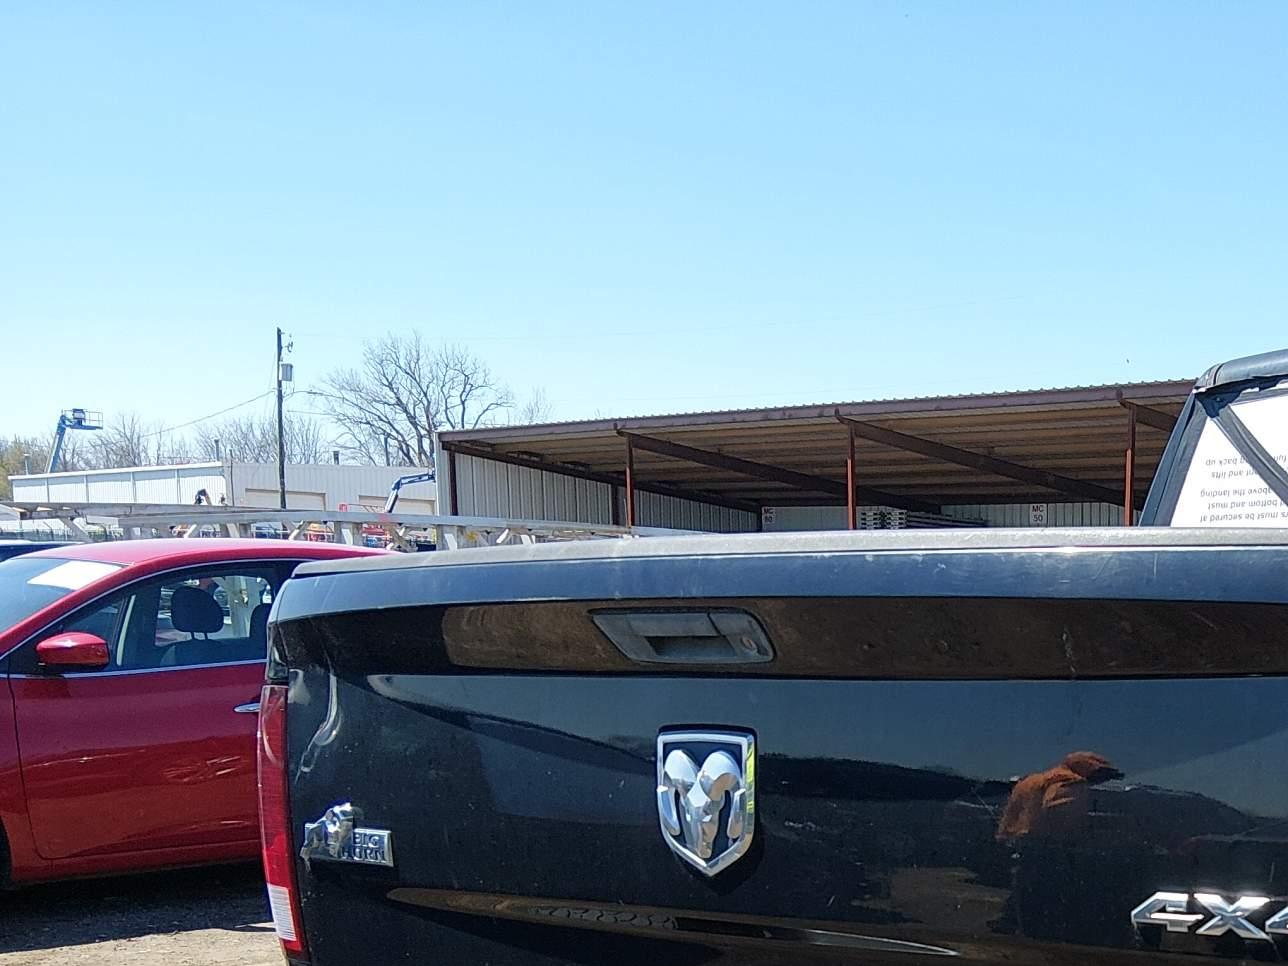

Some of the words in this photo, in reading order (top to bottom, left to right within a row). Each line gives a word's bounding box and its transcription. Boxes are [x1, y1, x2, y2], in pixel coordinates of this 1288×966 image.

[1205, 457, 1216, 466] up
[1218, 458, 1237, 466] back
[1211, 471, 1227, 479] lifts
[1228, 470, 1244, 478] and
[1200, 489, 1230, 498] landing
[1232, 488, 1245, 497] the
[1247, 487, 1272, 496] above
[1207, 502, 1228, 511] must
[1230, 500, 1246, 510] and
[1248, 499, 1278, 508] bottom
[1033, 514, 1044, 522] 50
[1210, 514, 1243, 523] secured
[1244, 513, 1254, 522] be
[1257, 512, 1278, 520] must
[352, 832, 380, 848] BIG
[342, 846, 386, 863] HORN
